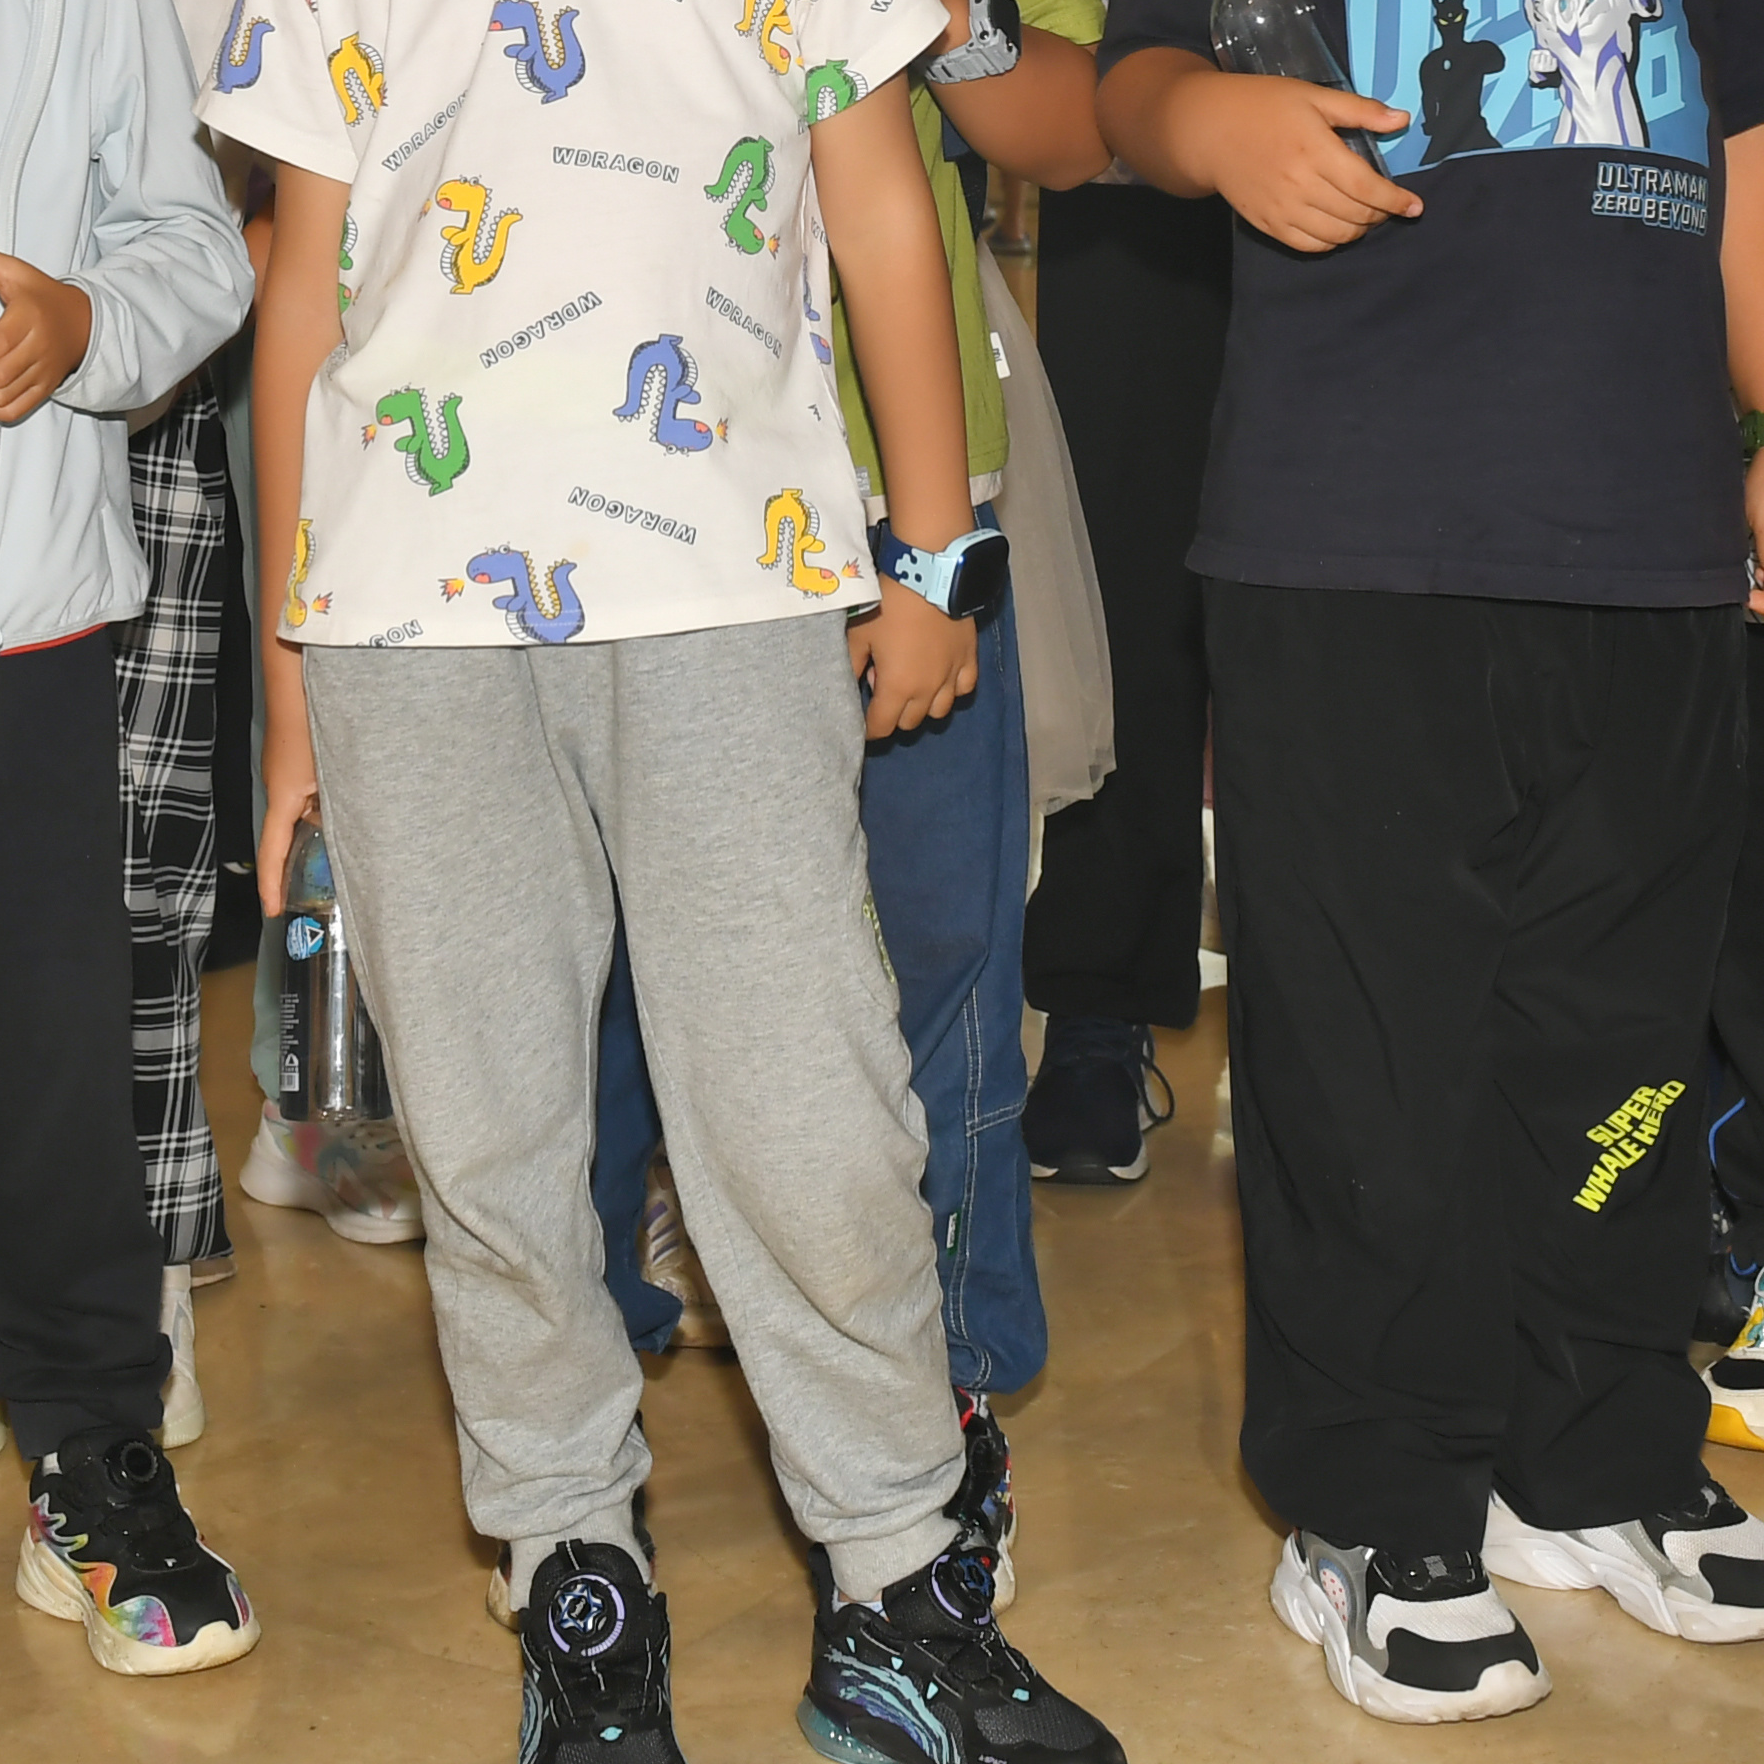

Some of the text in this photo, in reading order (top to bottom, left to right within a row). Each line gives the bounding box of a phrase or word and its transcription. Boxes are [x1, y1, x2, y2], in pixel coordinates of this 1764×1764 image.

[553, 146, 680, 184] WDRAGON
[1598, 163, 1708, 204] ULTRAMAN
[1592, 192, 1708, 233] ZERO BEYOND
[480, 291, 602, 369] WDRAGON
[705, 286, 783, 359] WDRAGON
[567, 486, 697, 545] WDRAGON
[1573, 1080, 1687, 1212] WHALE HERO
[1586, 1085, 1658, 1147] SUPER
